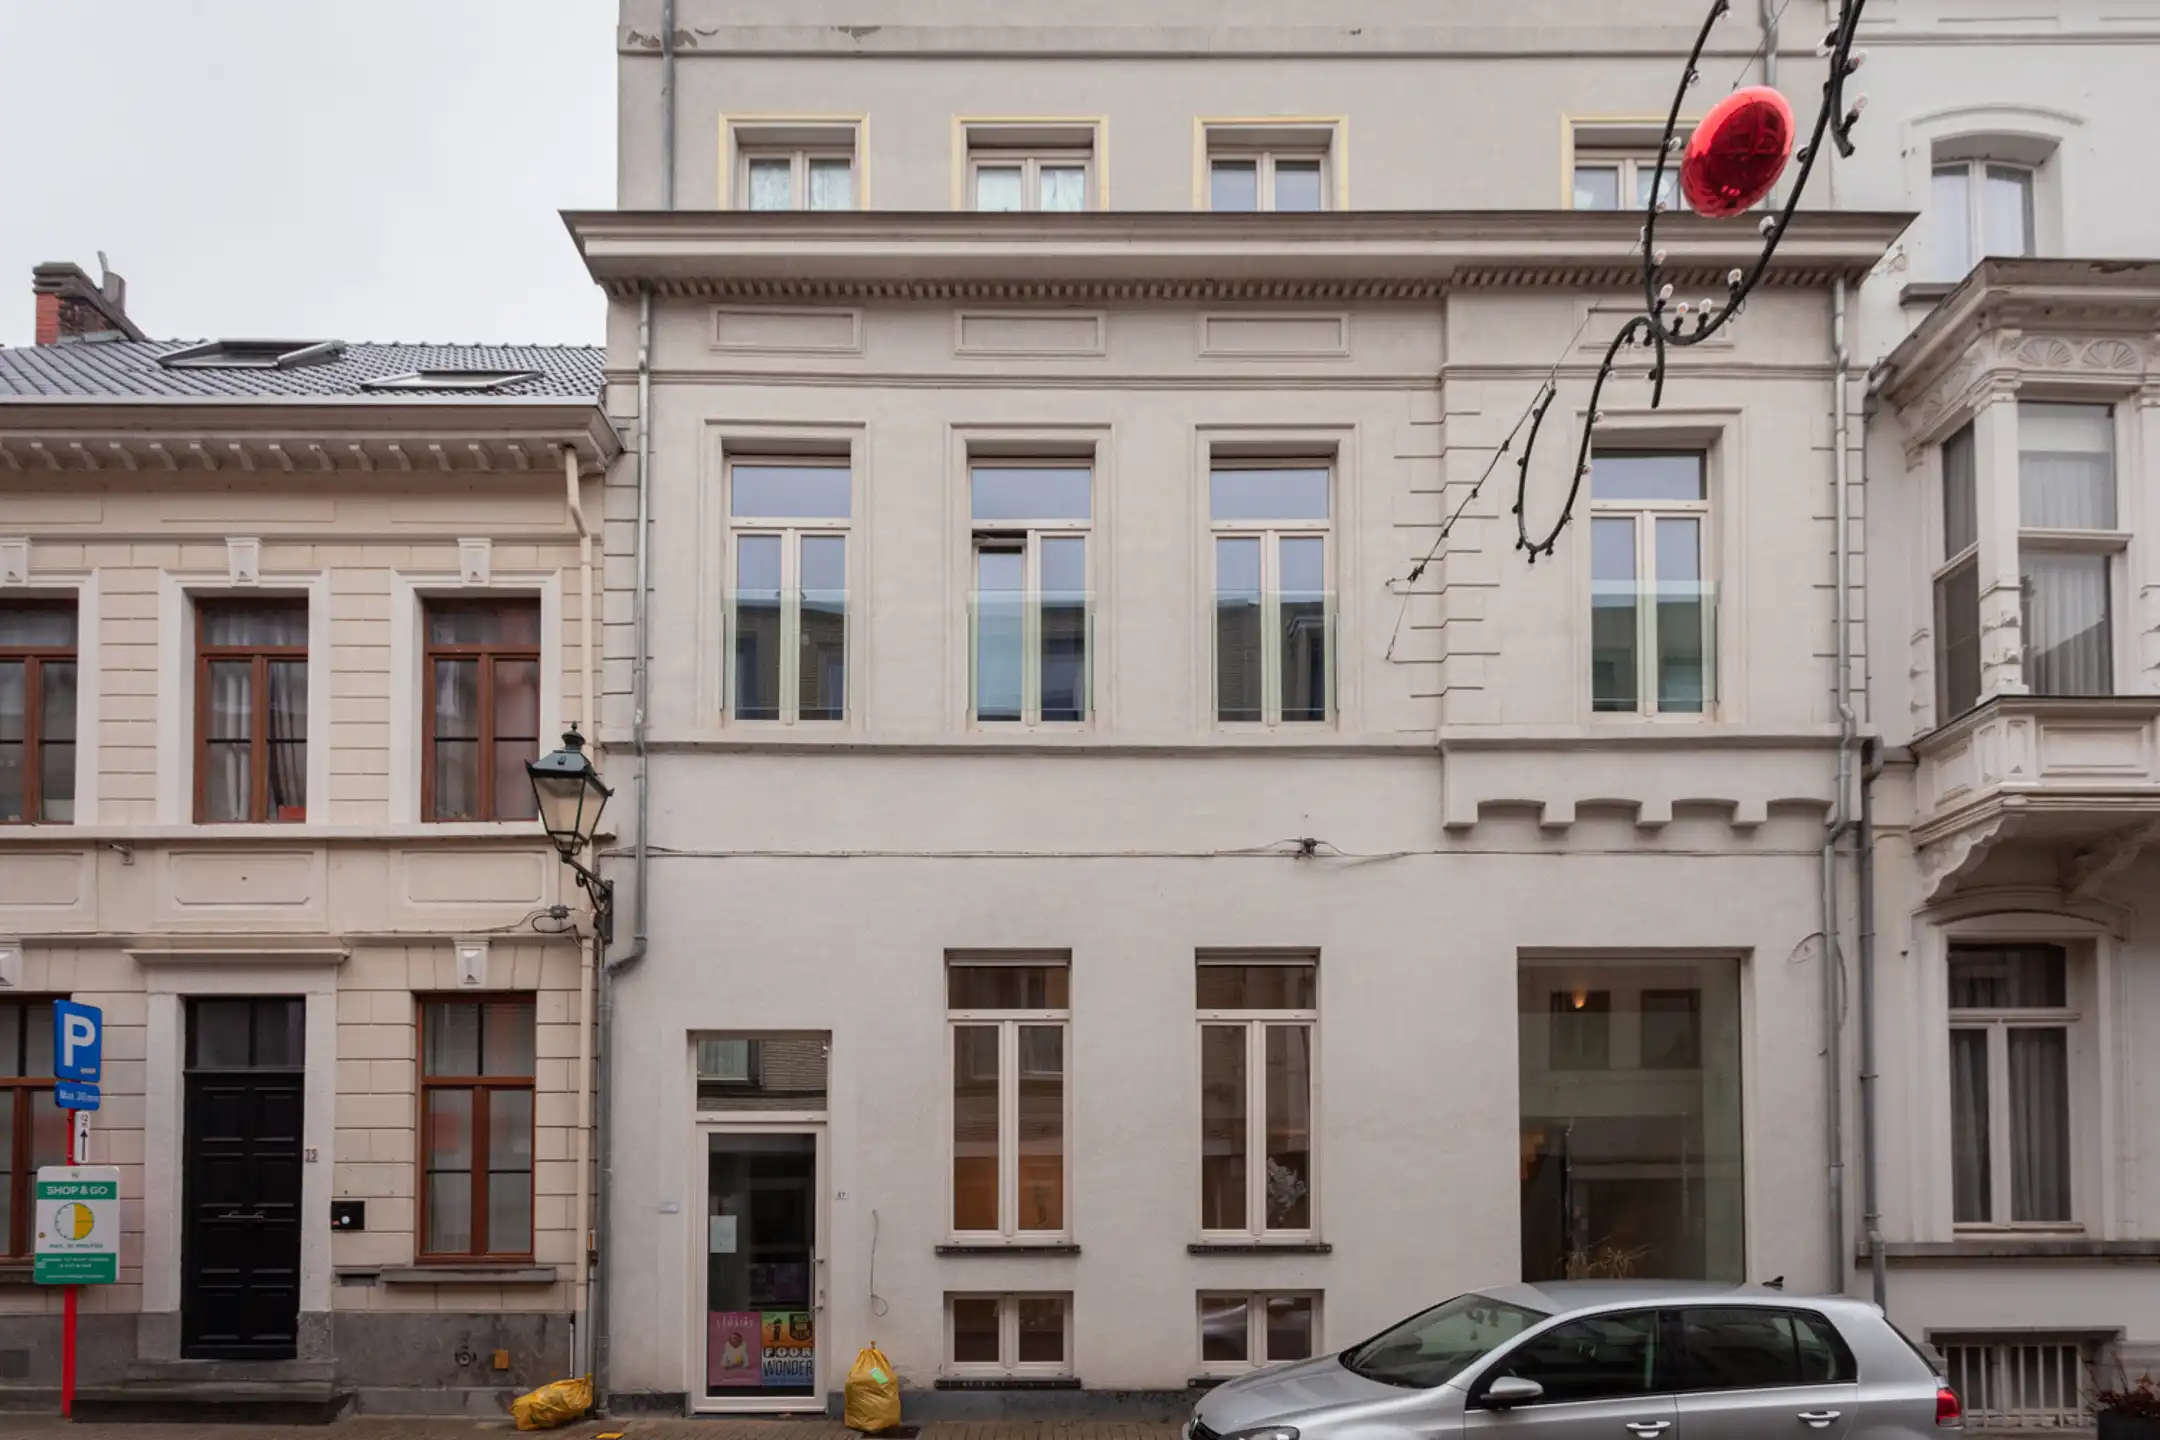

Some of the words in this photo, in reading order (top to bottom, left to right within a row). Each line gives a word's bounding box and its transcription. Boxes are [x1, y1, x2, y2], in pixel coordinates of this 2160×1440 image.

[63, 1013, 96, 1066] P
[46, 1186, 79, 1196] SHOP
[80, 1184, 89, 1196] &
[90, 1186, 108, 1196] GO
[763, 1360, 813, 1377] WONDER
